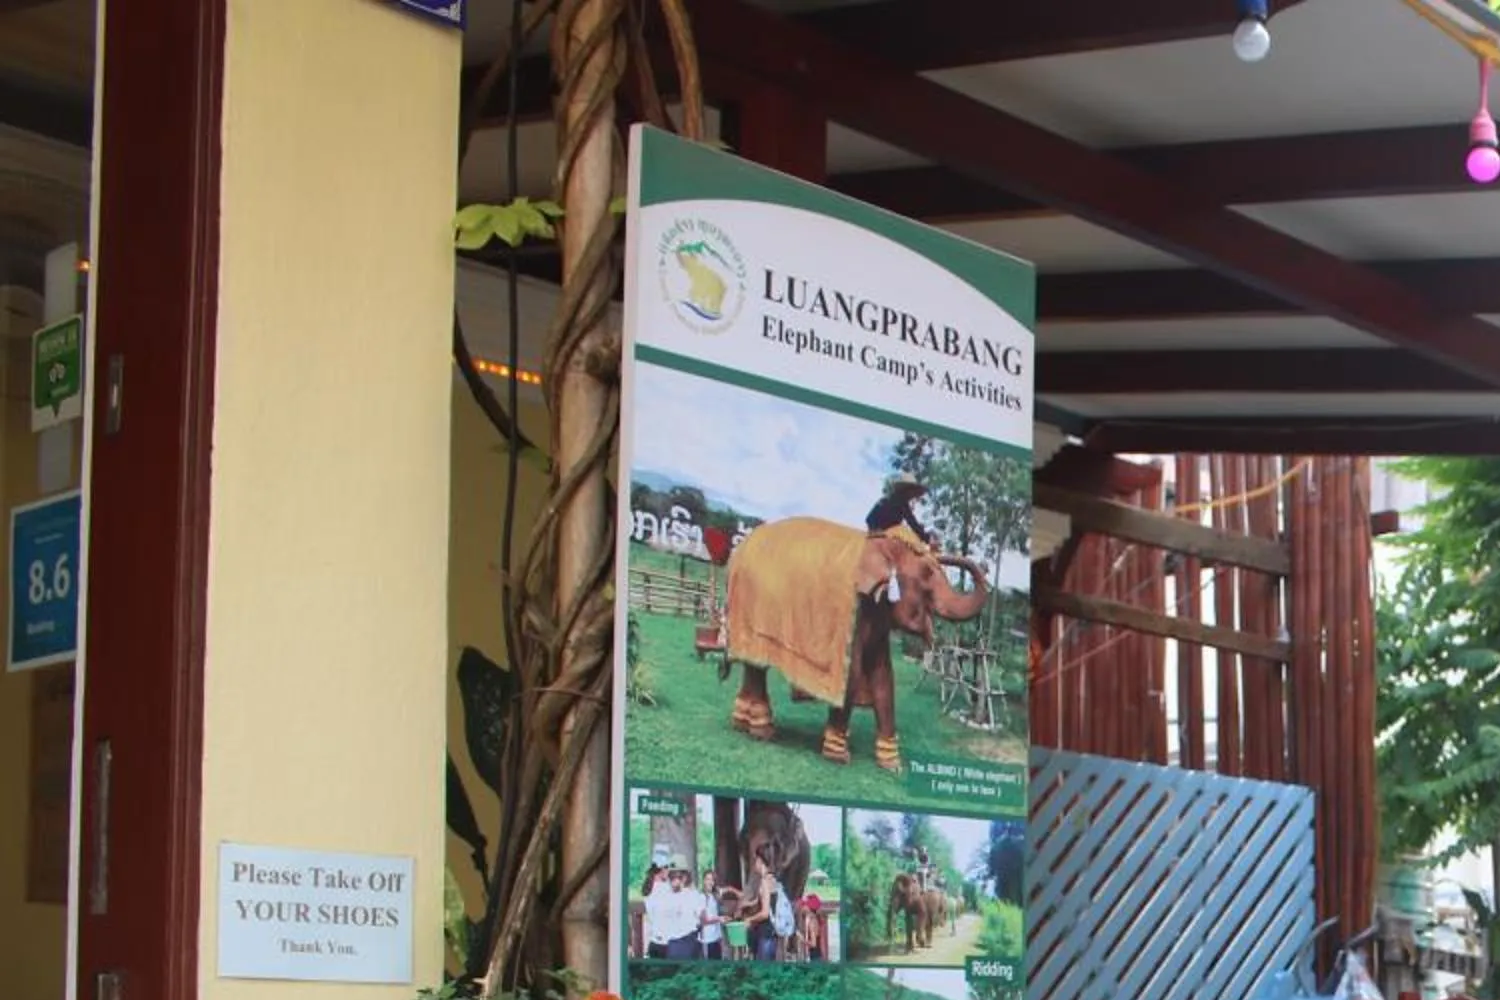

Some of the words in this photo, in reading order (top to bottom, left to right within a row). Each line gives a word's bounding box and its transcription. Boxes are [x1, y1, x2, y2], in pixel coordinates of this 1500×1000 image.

[764, 269, 1023, 377] LUANGPRABANG
[762, 315, 854, 362] Elephant
[860, 345, 934, 386] Camp's
[940, 370, 1023, 411] Activities
[29, 553, 71, 605] 8.6
[641, 798, 679, 816] Feeding
[232, 862, 302, 886] Please
[309, 867, 363, 890] Take
[368, 871, 405, 893] Off
[235, 899, 311, 923] YOUR
[317, 903, 400, 928] SHOES
[279, 937, 324, 954] Thank
[971, 960, 1013, 981] Ridding
